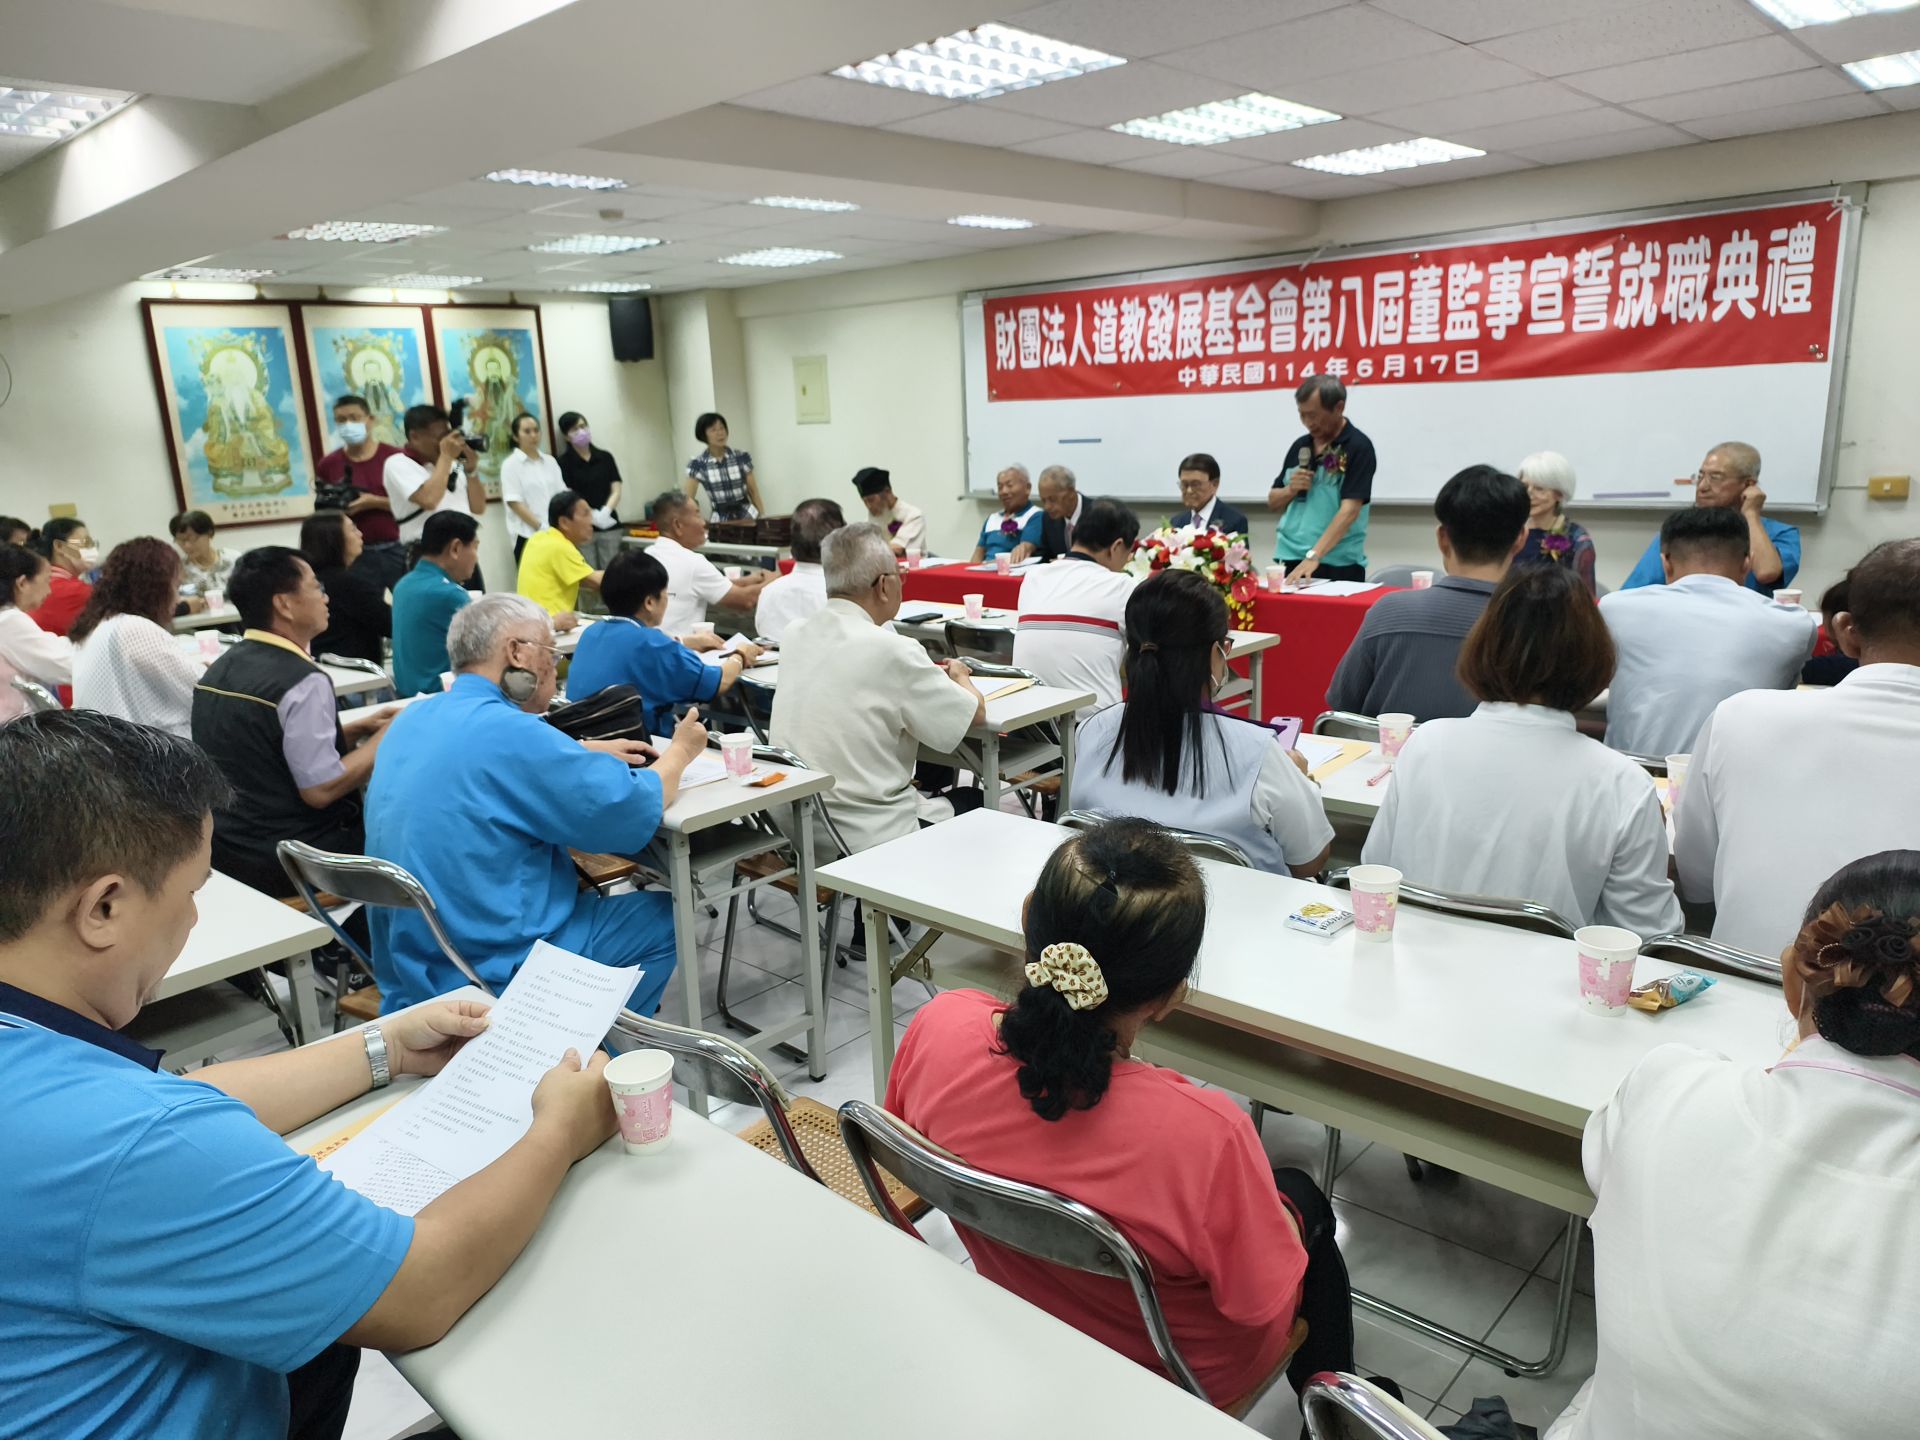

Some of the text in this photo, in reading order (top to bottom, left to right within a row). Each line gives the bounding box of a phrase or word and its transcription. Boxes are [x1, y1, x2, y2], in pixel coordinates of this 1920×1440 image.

[995, 221, 1816, 371] 財團法人道教發展基金會第八屆董監事宣誓就職典禮
